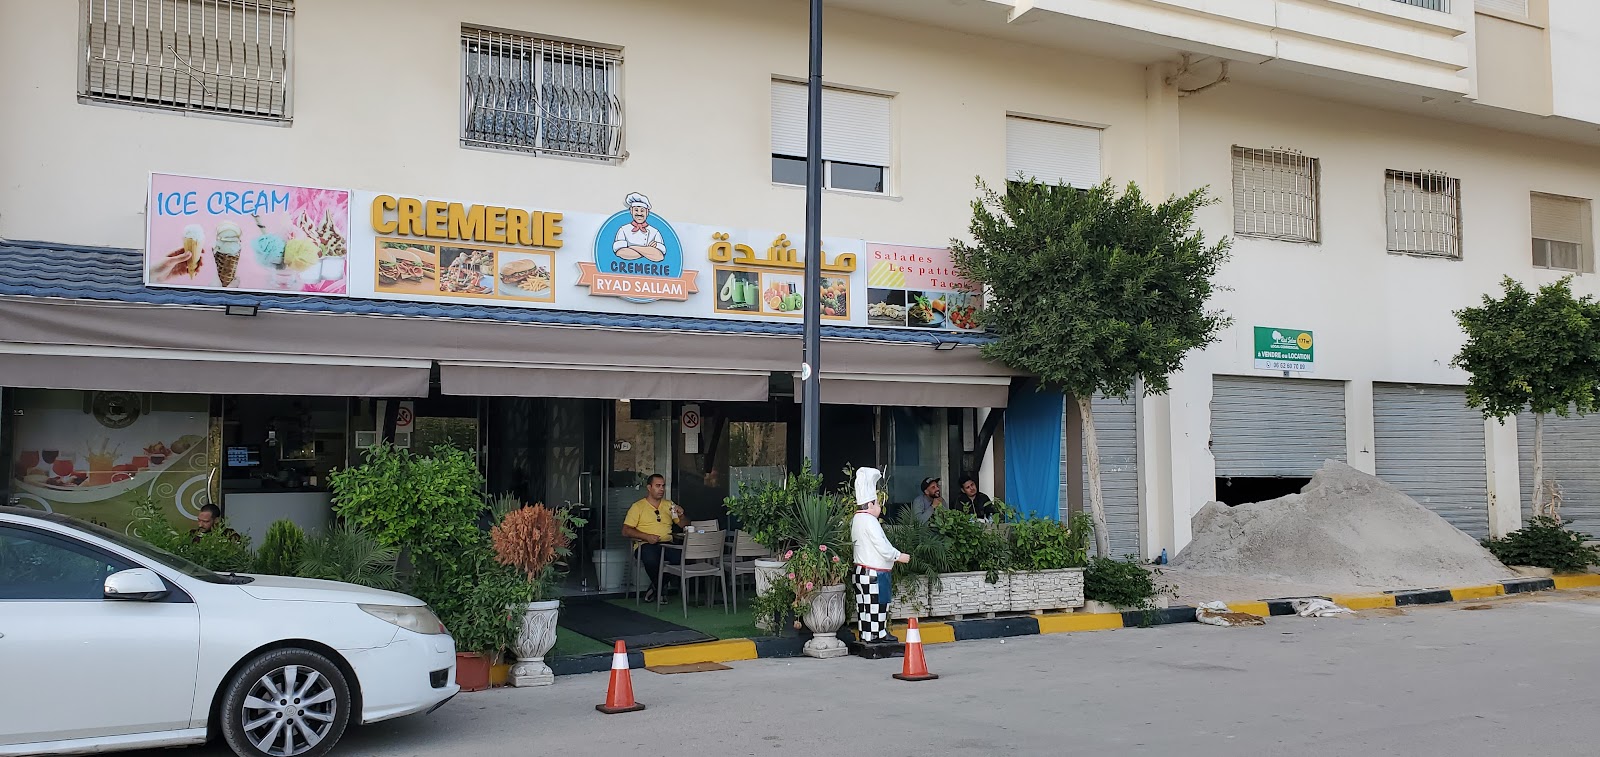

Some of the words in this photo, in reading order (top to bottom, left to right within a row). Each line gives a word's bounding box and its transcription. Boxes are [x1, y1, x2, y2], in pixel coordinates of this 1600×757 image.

[157, 191, 199, 216] ICE
[207, 190, 290, 215] CREAM
[370, 194, 564, 248] CREMERIE
[708, 231, 857, 273] مشدة
[874, 250, 933, 264] Salades
[610, 260, 670, 276] CREMERIE
[889, 263, 913, 273] Les
[919, 266, 963, 277] patte
[596, 278, 632, 292] RYAD
[634, 280, 683, 295] SALLAM
[1261, 350, 1281, 358] VENDRE
